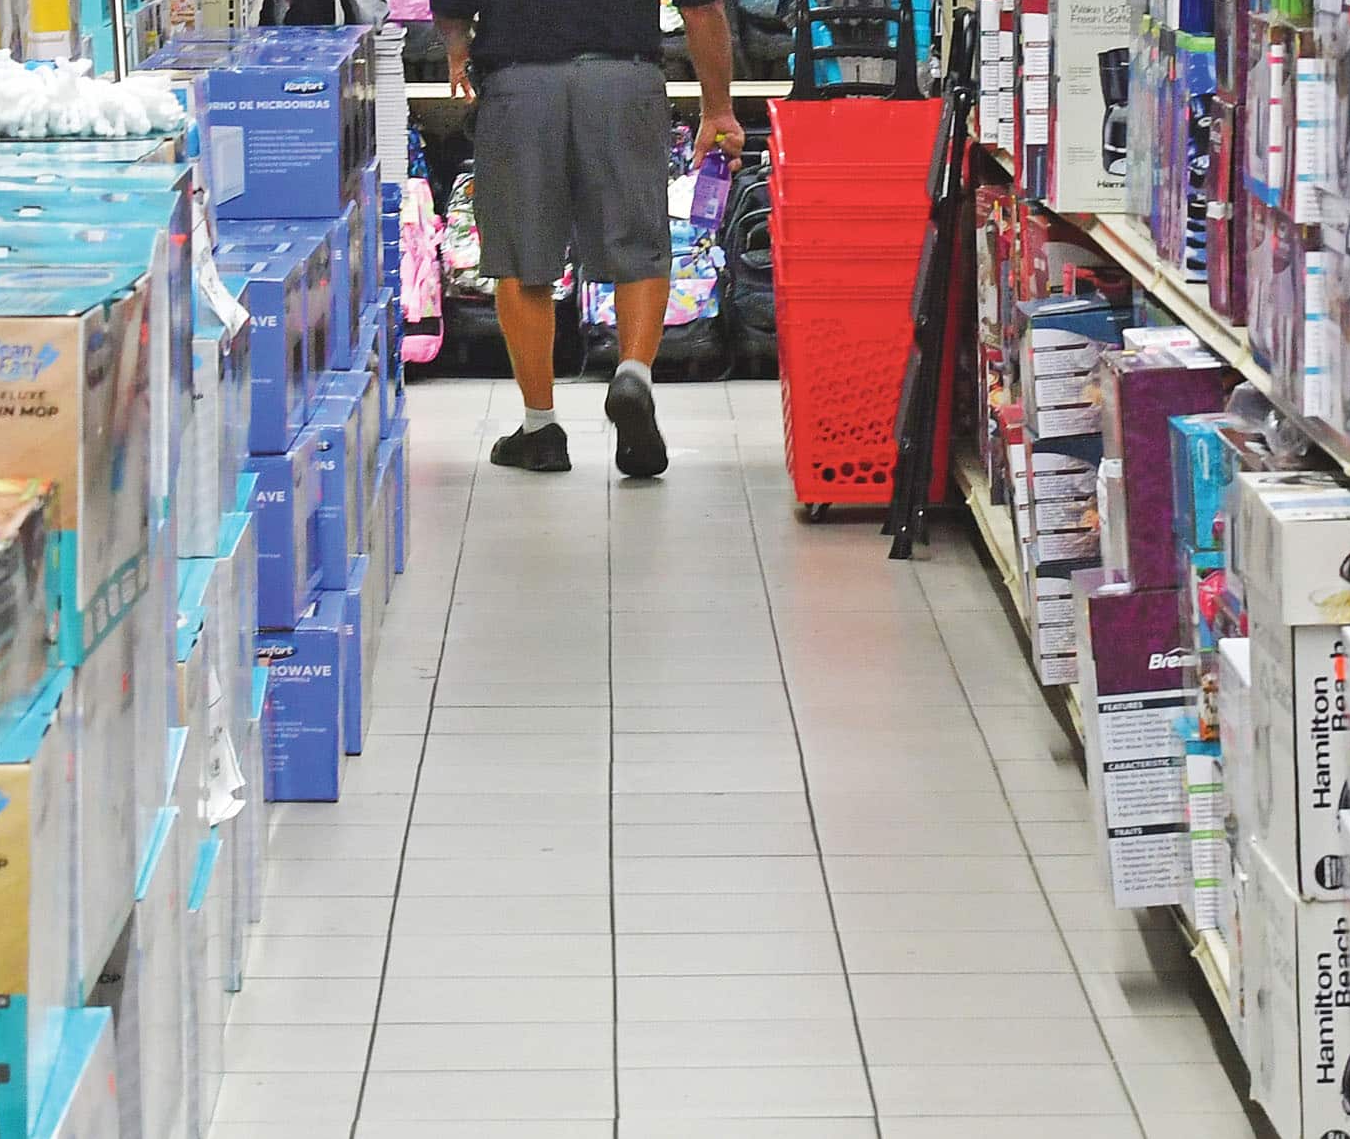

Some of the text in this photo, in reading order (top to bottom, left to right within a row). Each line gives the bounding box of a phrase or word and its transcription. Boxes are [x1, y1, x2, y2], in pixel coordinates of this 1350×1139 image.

[283, 80, 325, 93] Konfort
[239, 100, 254, 110] DE
[256, 100, 331, 110] MICROONDAS
[20, 405, 59, 418] MOP
[257, 645, 294, 658] onfort
[1331, 640, 1347, 732] Beah
[1103, 701, 1144, 712] FEATURES
[1312, 676, 1331, 809] Hamilton
[1108, 757, 1171, 770] CARACTERISTIC
[1114, 827, 1143, 837] TRAITS
[1335, 916, 1349, 1008] Beach
[1314, 951, 1335, 1084] Hamilton
